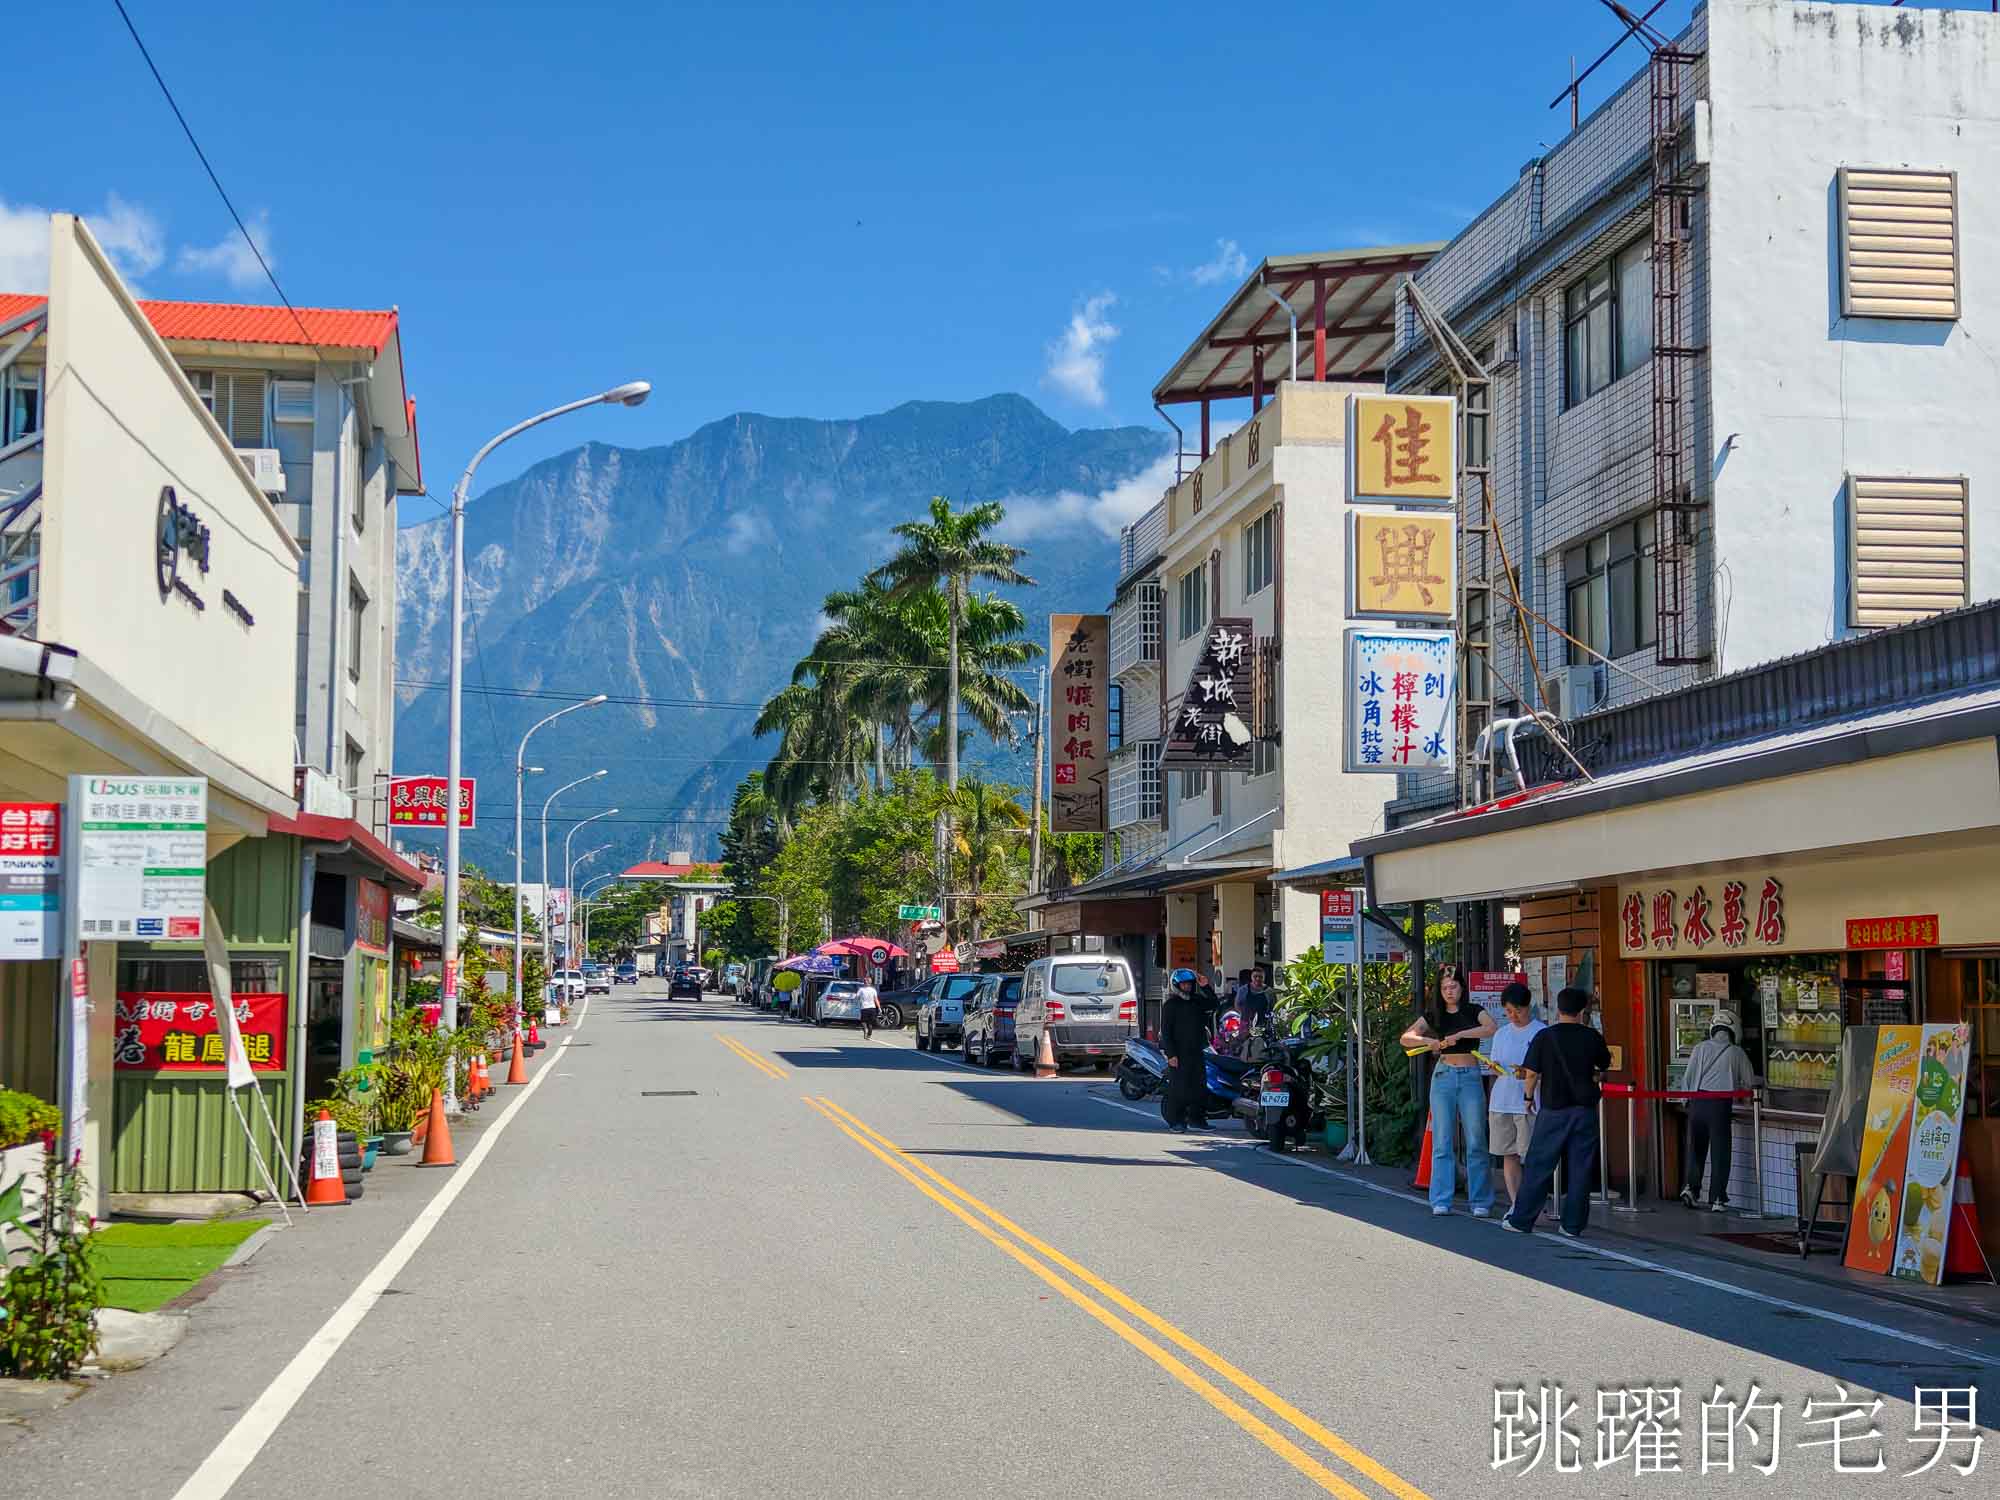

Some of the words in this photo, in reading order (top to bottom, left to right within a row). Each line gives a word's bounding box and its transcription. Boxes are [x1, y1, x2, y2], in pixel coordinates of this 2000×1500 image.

[1359, 670, 1385, 764] 冰角批發
[1391, 671, 1419, 765] 檸檬汁
[1, 809, 55, 826] 台灣
[1, 833, 55, 849] 好行
[1622, 878, 1781, 951] 佳興冰菓店
[873, 951, 885, 960] 40
